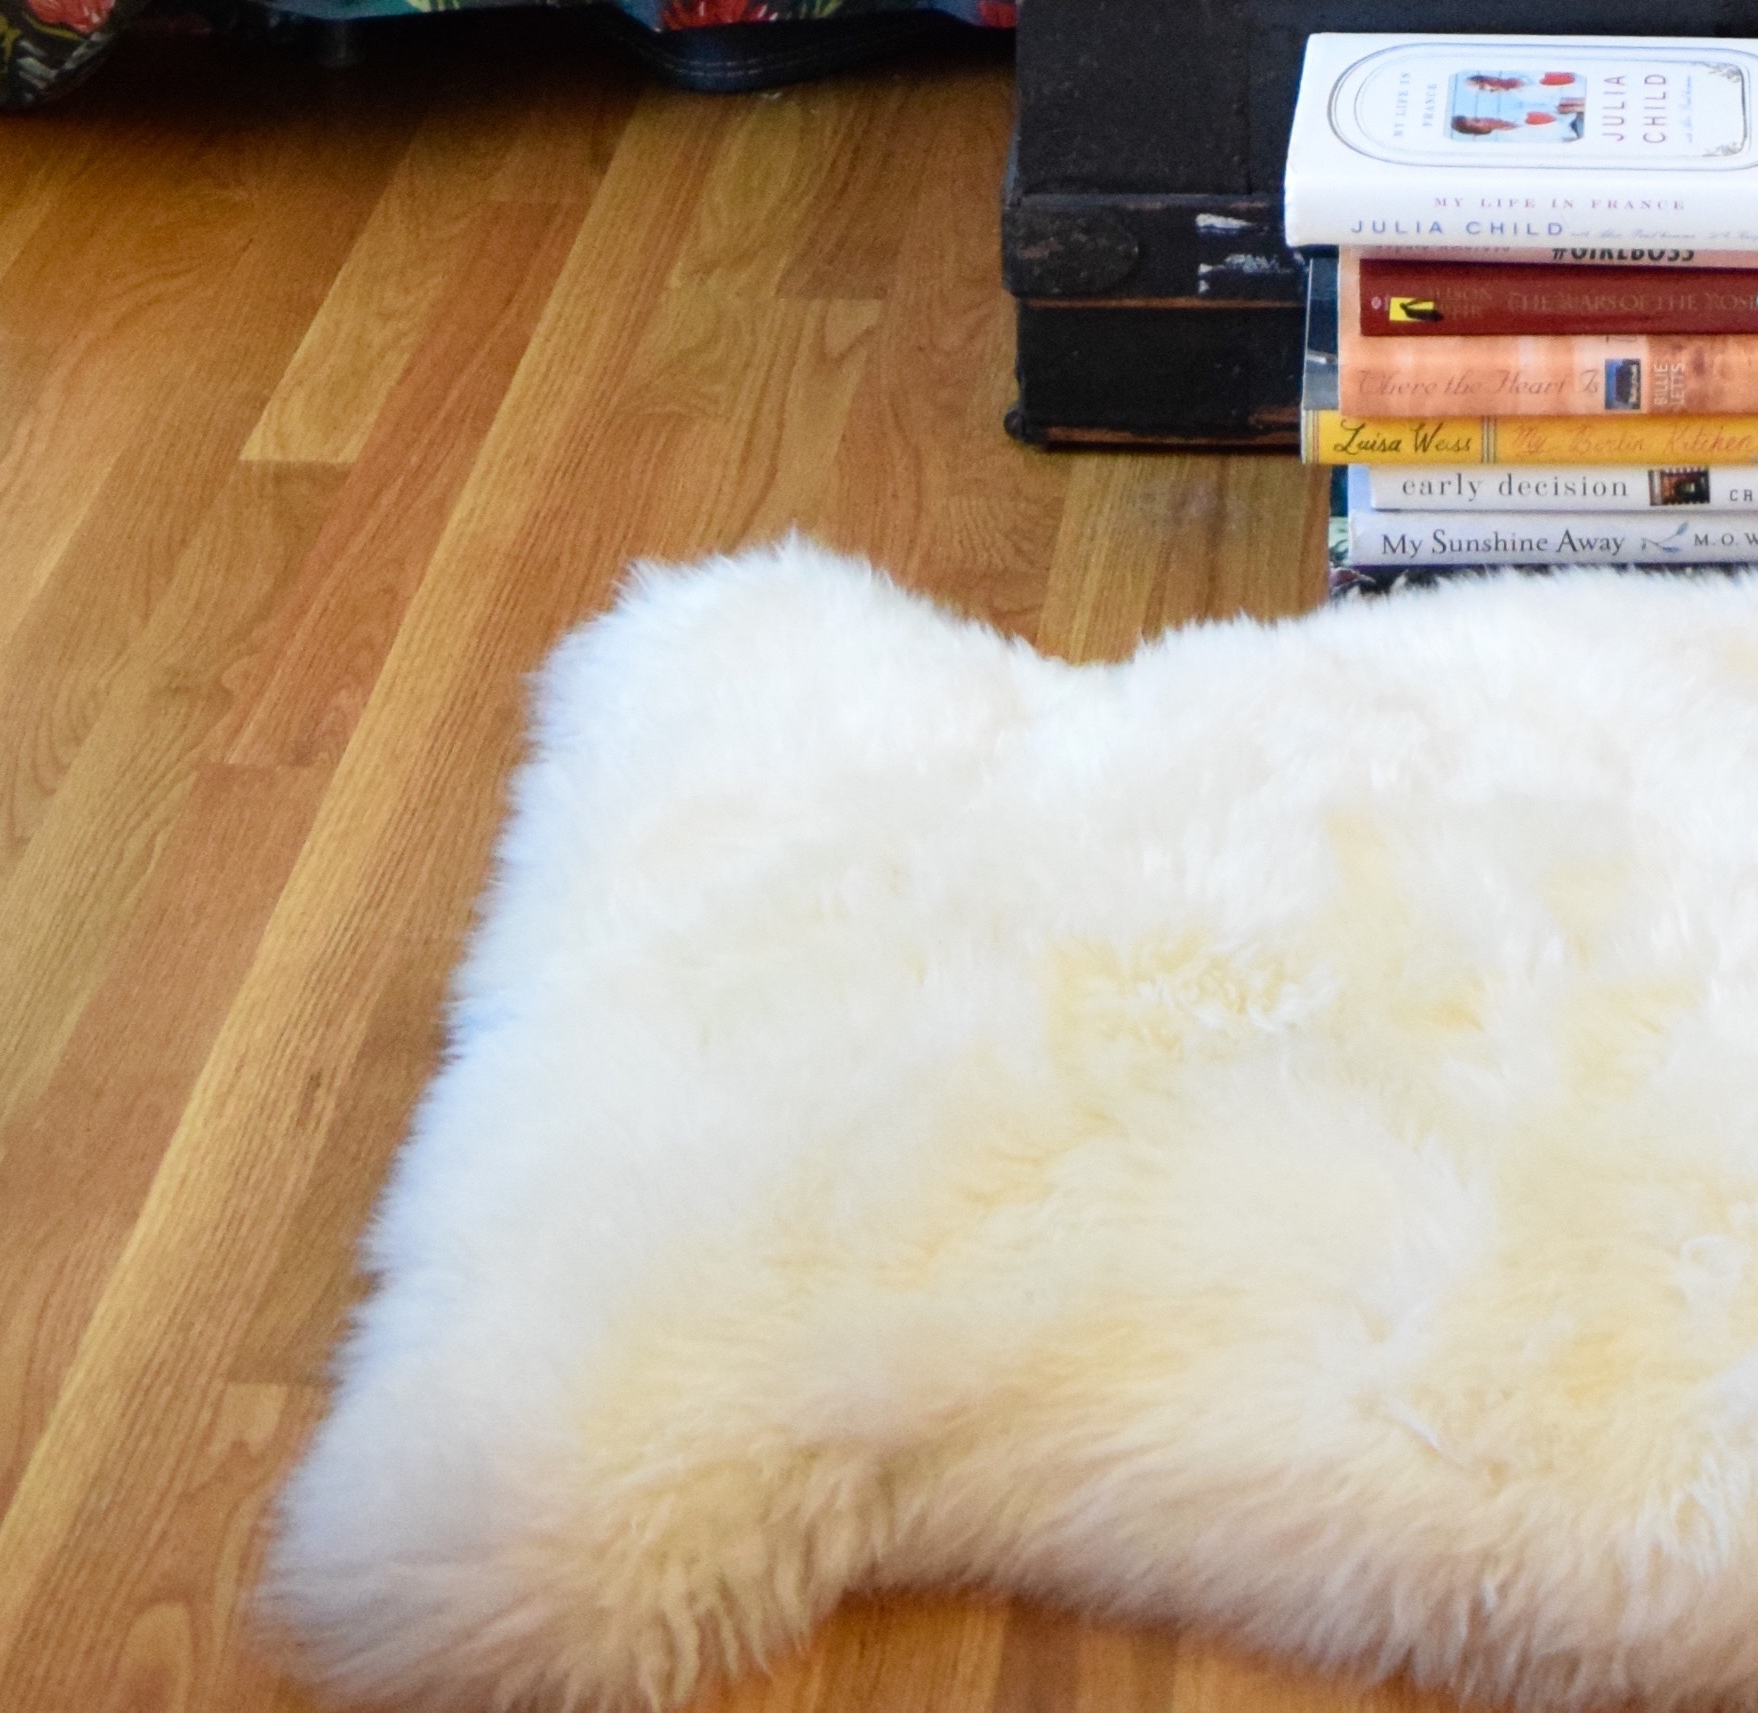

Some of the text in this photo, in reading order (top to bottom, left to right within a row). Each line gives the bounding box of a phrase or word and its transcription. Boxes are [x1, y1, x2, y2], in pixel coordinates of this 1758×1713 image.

[1601, 75, 1626, 142] JULIA
[1642, 74, 1667, 144] CHILD
[1434, 197, 1685, 210] MY LIFE IN FRANCE
[1350, 220, 1444, 234] JULIA
[1465, 221, 1563, 236] CHILD
[1656, 294, 1698, 312] THE
[1357, 369, 1438, 396] Where
[1442, 370, 1482, 396] the
[1491, 368, 1567, 396] Heart
[1332, 421, 1402, 454] Luisa
[1662, 423, 1753, 455] Kitchen
[1402, 473, 1628, 503] early decision
[1381, 529, 1626, 558] My Sunshine Away
